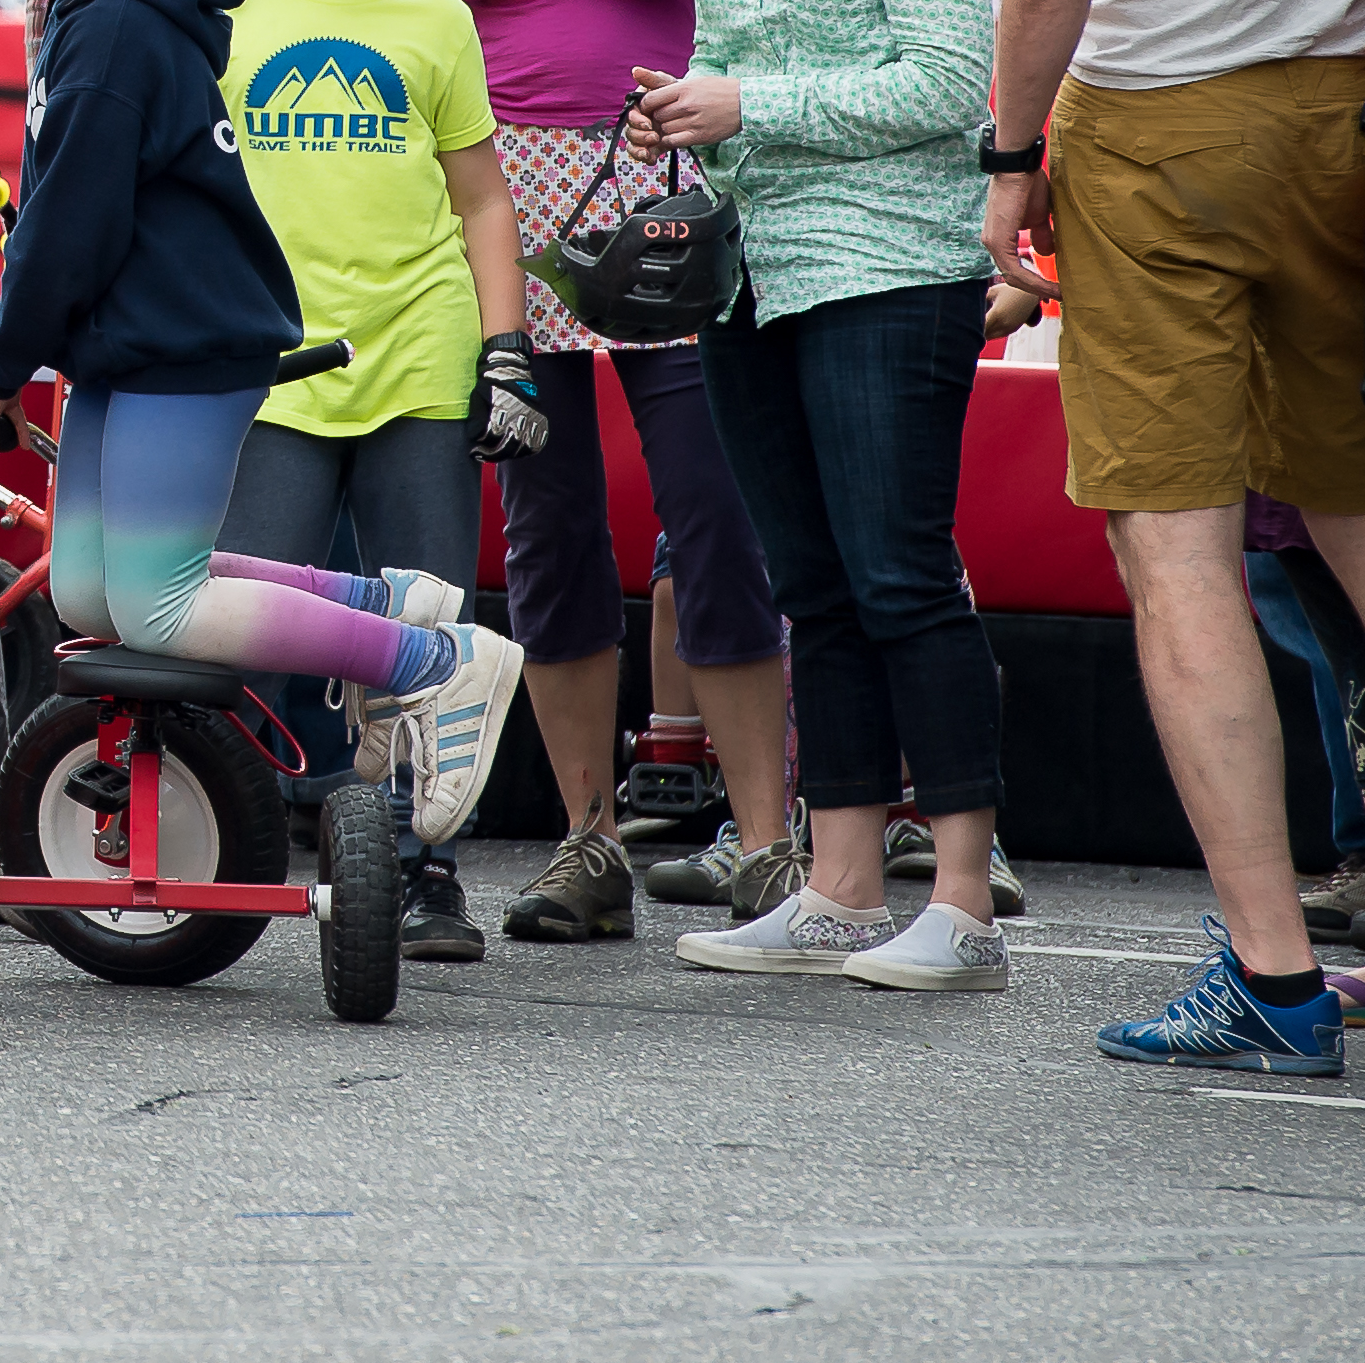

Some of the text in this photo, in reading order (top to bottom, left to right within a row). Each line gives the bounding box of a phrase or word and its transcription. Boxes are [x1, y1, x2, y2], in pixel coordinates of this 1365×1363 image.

[244, 112, 409, 142] WMBC
[248, 139, 407, 155] SAVE THE TRAILS
